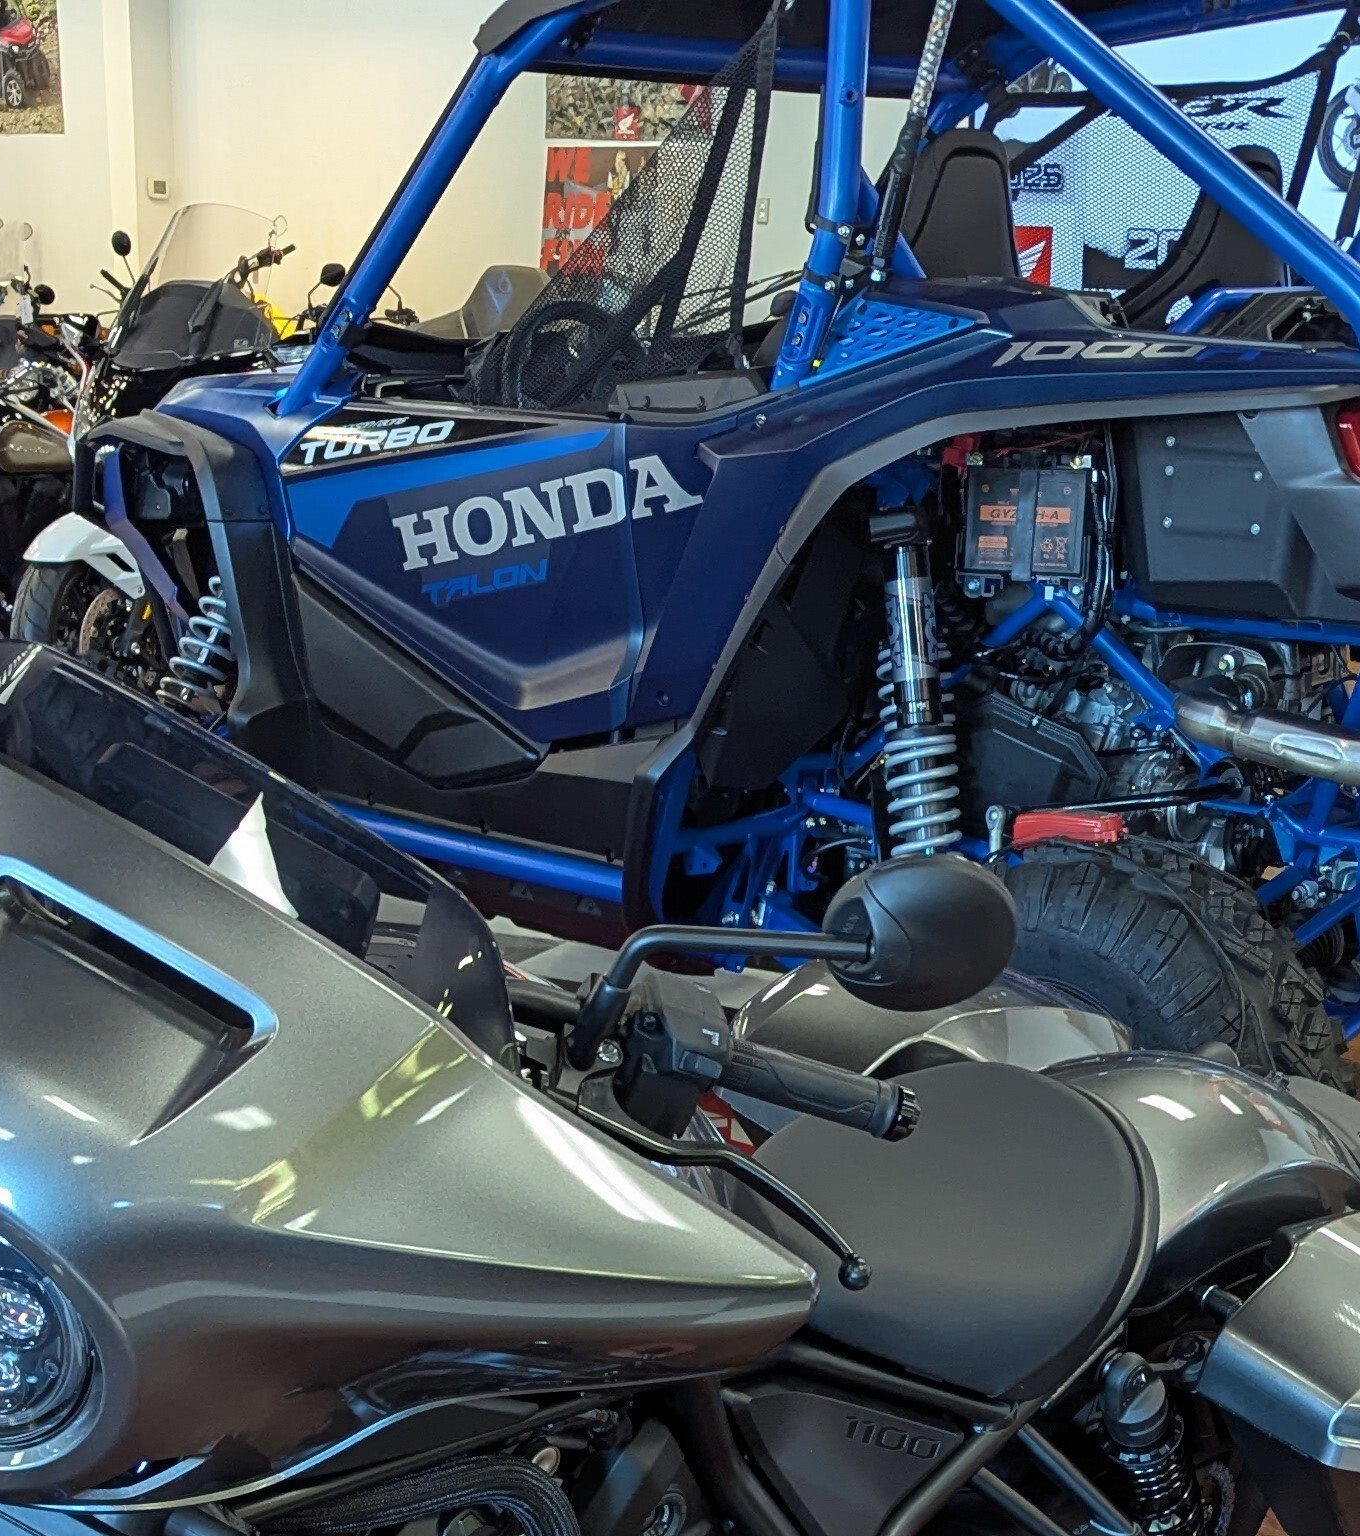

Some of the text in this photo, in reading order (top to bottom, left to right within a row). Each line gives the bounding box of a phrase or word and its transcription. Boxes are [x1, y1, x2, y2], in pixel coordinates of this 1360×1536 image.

[547, 146, 591, 182] WE
[299, 419, 456, 465] TURBO
[391, 454, 705, 571] HONDA
[990, 507, 1061, 521] GYZH-A
[420, 558, 550, 608] TALON
[845, 1415, 941, 1460] 1100
